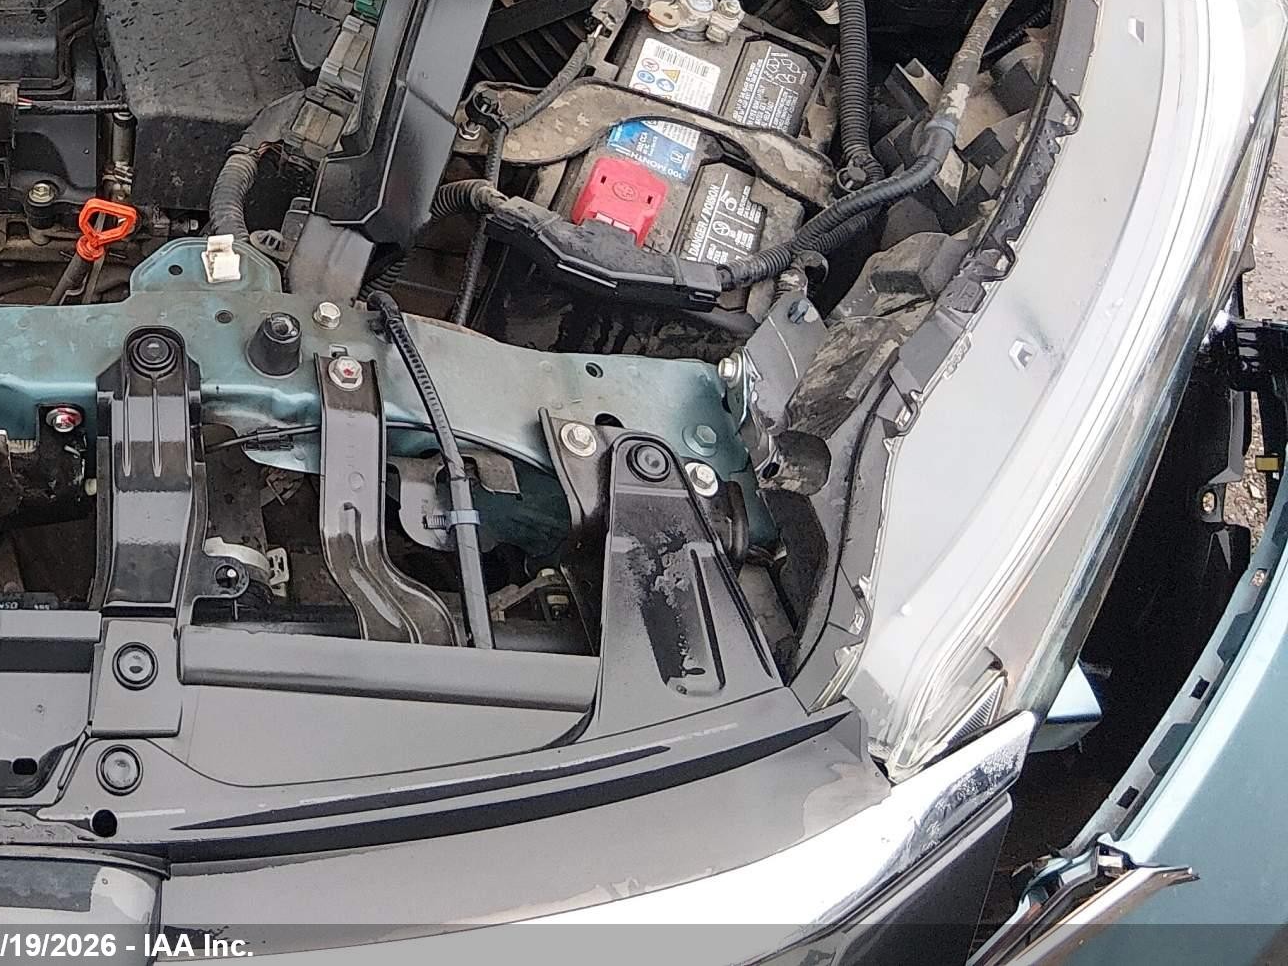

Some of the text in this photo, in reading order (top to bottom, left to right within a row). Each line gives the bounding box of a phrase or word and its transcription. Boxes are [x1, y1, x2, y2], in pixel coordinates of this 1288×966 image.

[629, 152, 667, 172] MONTH
[668, 168, 683, 179] 100
[688, 220, 708, 256] DANGER
[702, 184, 720, 216] POISON
